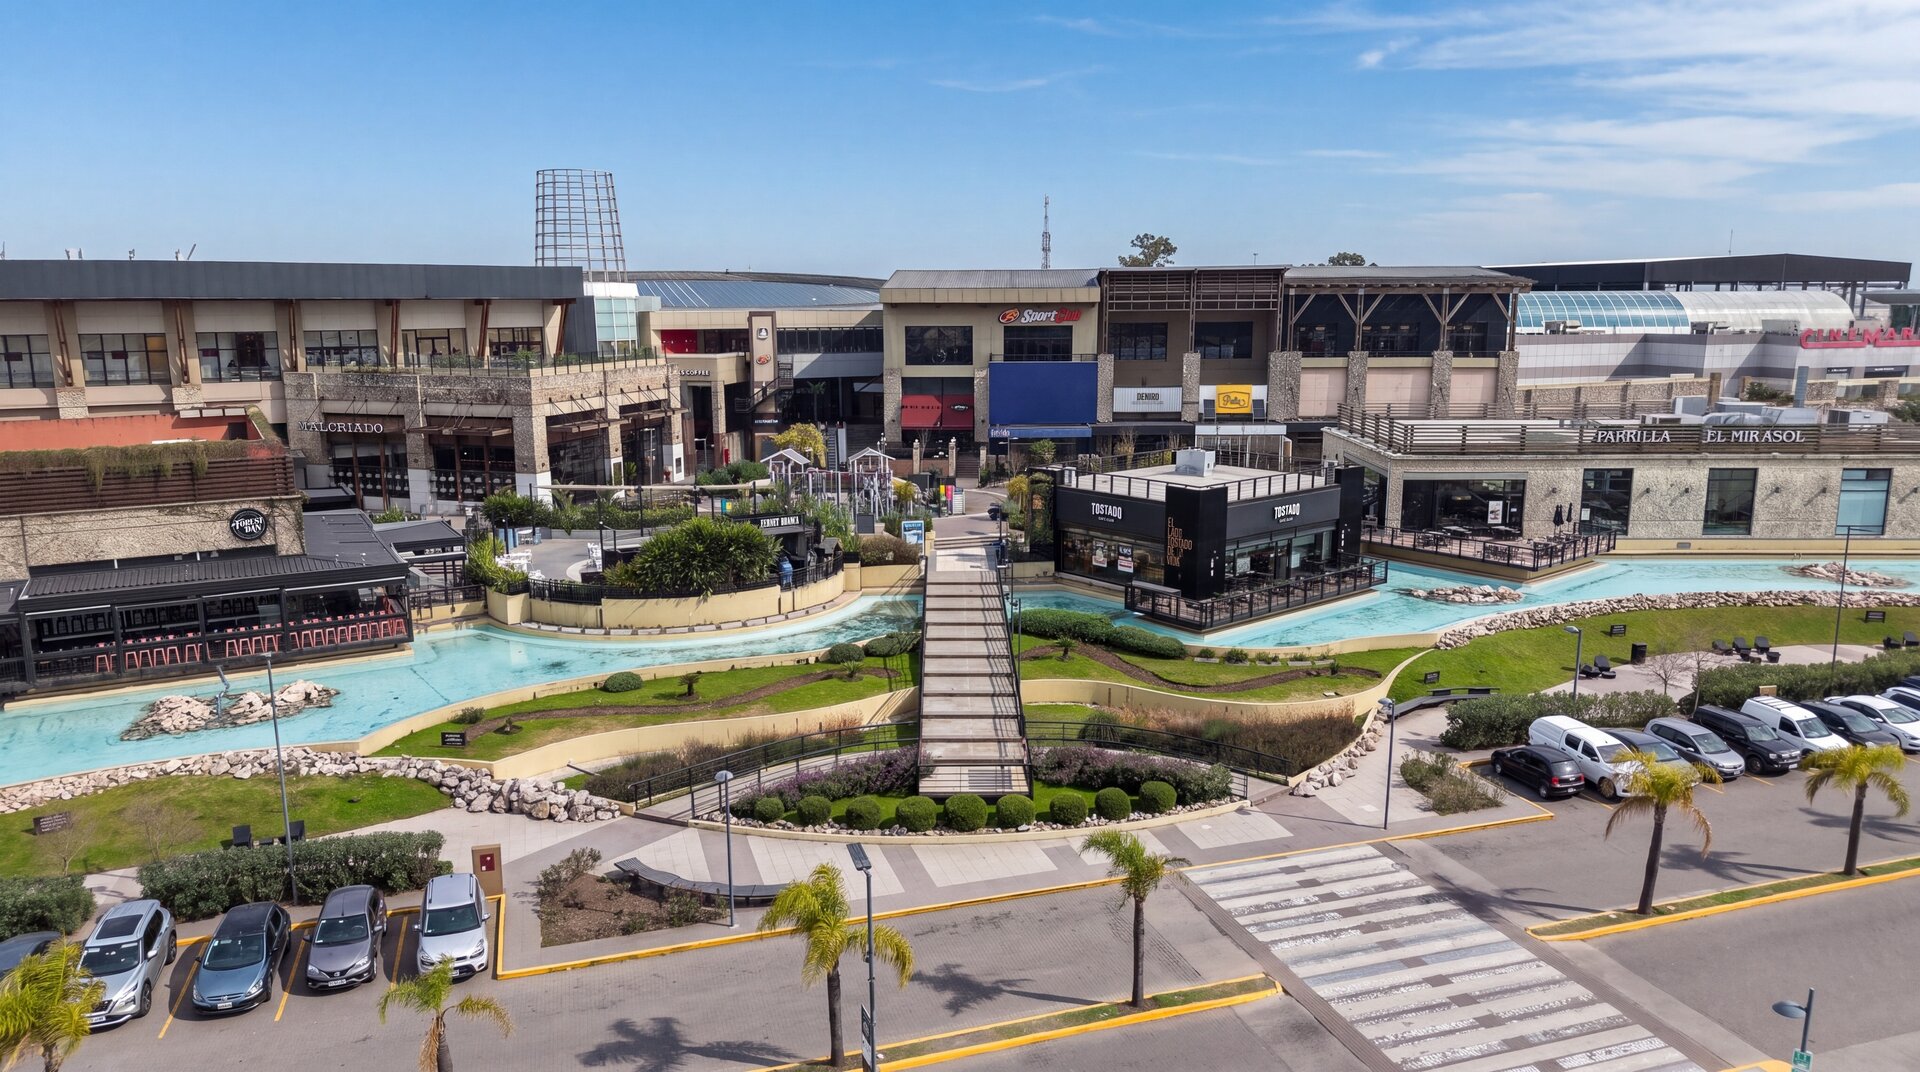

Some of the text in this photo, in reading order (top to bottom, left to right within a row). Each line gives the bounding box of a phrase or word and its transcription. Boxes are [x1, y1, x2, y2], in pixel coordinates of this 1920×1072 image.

[1800, 327, 1920, 349] CINEMAR
[298, 421, 384, 433] MALCRIADO
[1597, 430, 1671, 443] PARRILLA
[1706, 430, 1726, 443] EL
[1091, 502, 1122, 520] TOSTADO
[1274, 502, 1301, 520] TOSTADO
[244, 525, 262, 533] DAN
